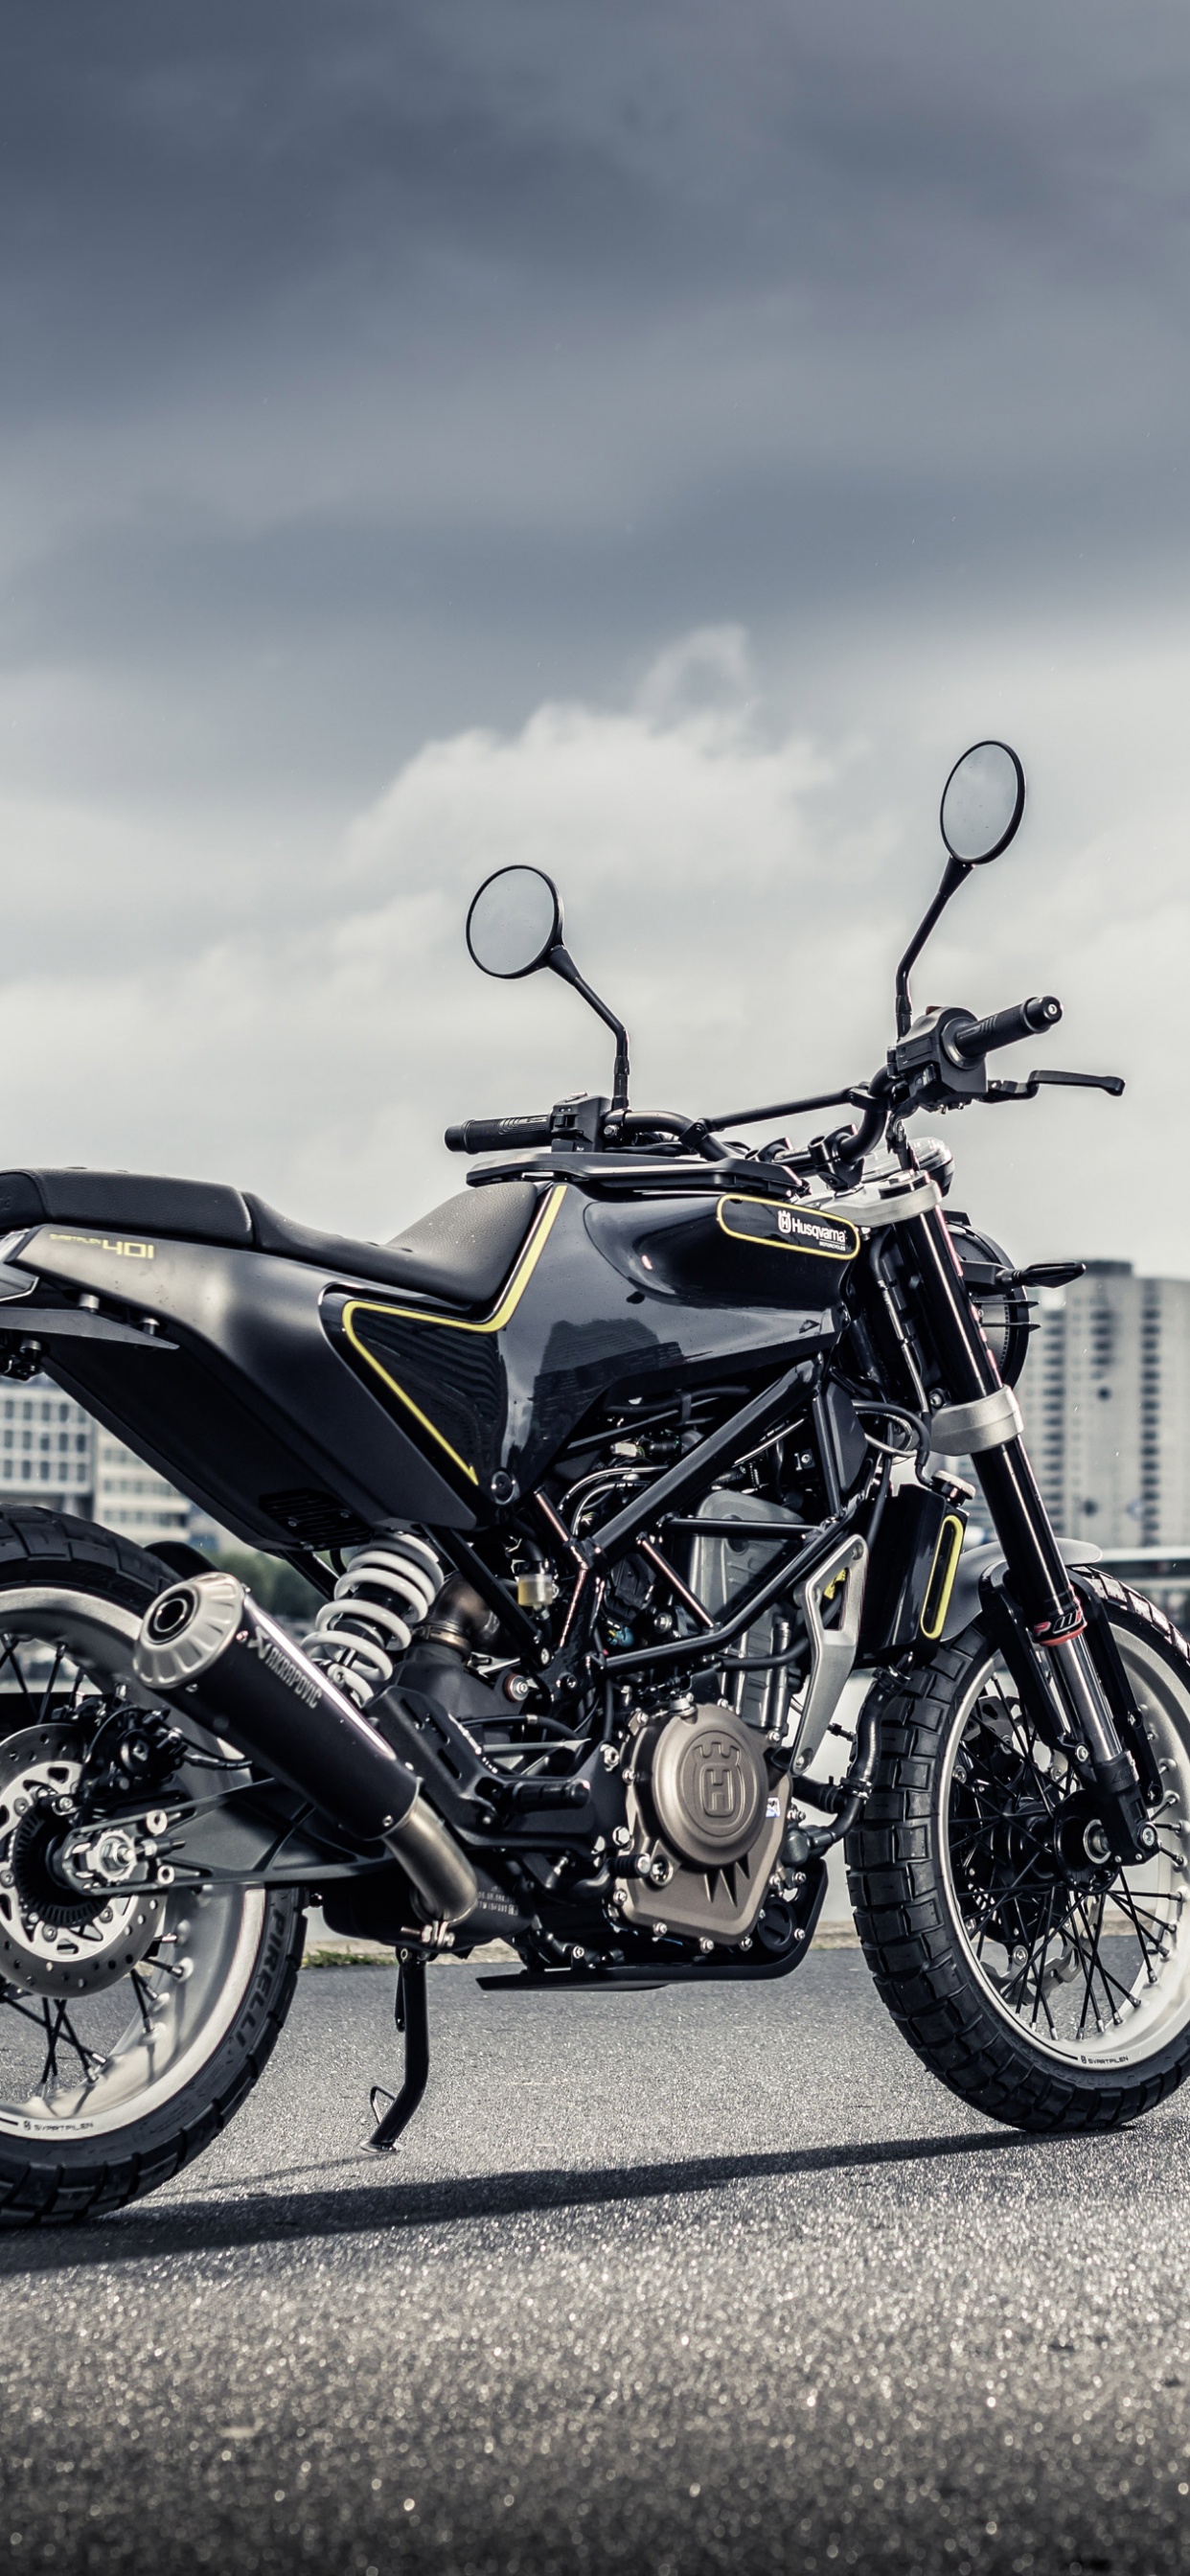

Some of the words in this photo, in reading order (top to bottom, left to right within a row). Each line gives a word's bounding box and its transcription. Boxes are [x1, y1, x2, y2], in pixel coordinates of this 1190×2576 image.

[791, 1217, 846, 1243] Husqvarna
[102, 1239, 154, 1259] 401
[235, 1908, 286, 2048] PIRELLI
[1087, 2055, 1129, 2064] SVARTPILEN
